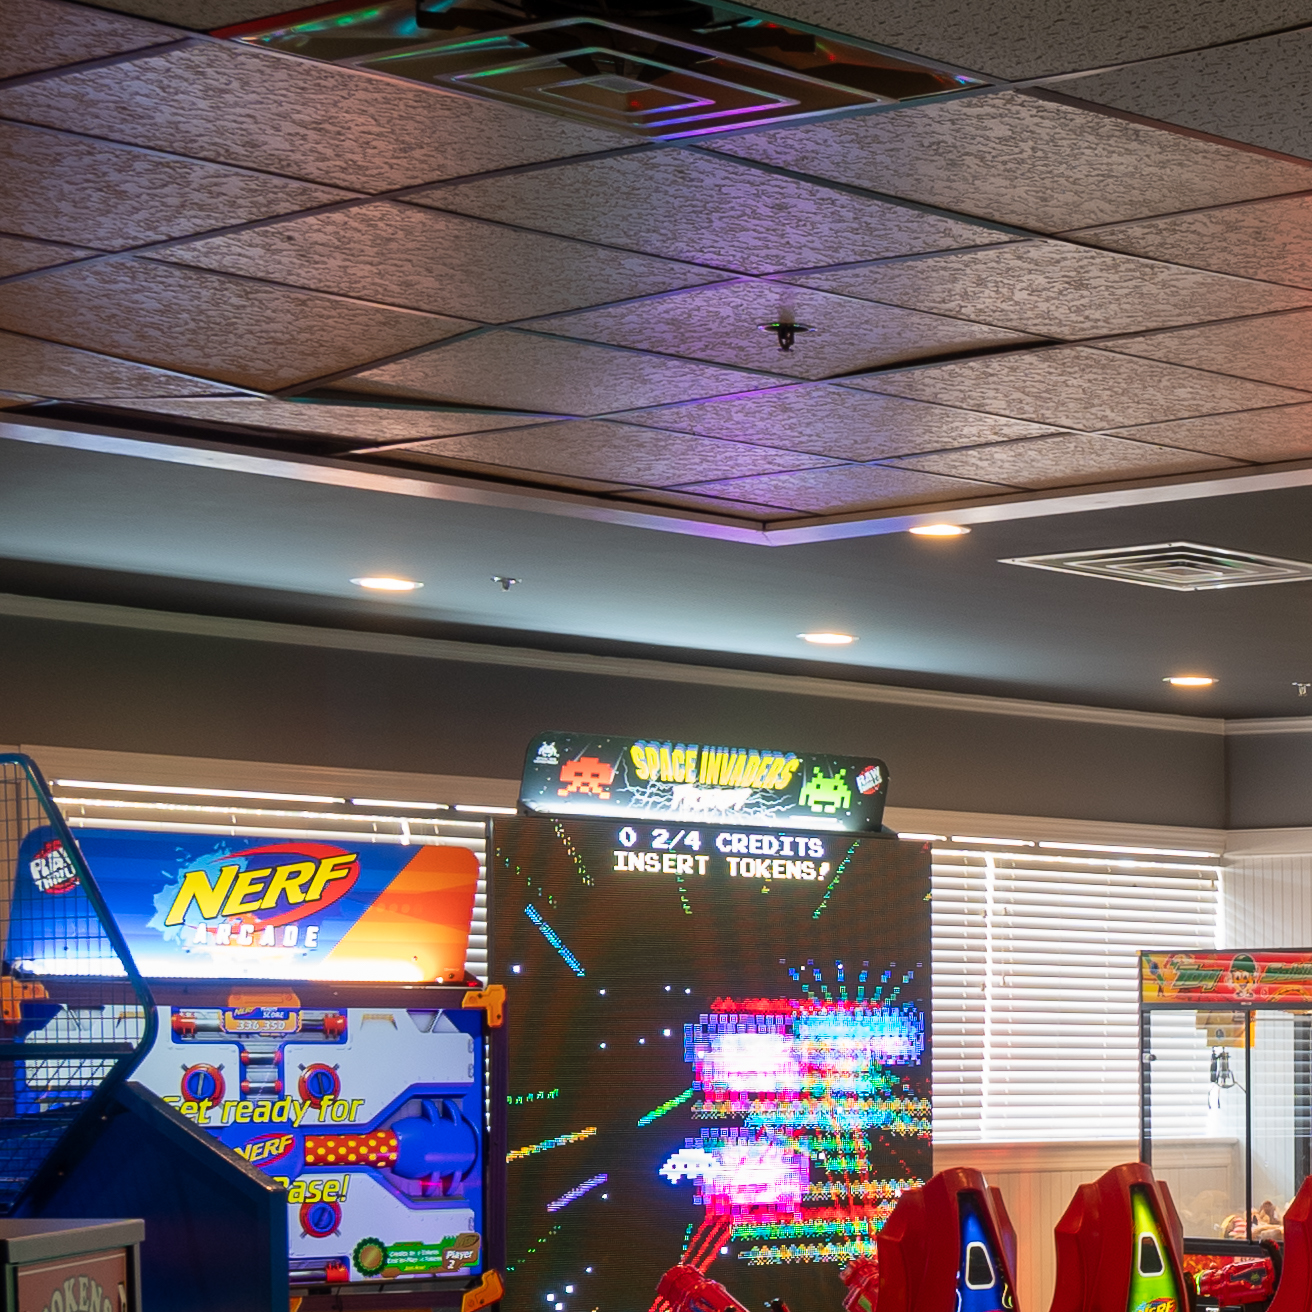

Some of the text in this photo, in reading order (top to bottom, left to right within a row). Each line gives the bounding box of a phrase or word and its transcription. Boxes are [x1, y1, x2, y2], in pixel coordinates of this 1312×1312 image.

[630, 740, 799, 790] SPACE INVADERS
[652, 828, 701, 850] 2/4
[716, 833, 823, 858] CREDITS
[614, 851, 831, 881] INSERT TOKENS!
[164, 852, 357, 926] NERF
[193, 925, 320, 948] ARCADE
[222, 1094, 308, 1127] ready
[318, 1094, 364, 1124] for
[272, 1175, 350, 1203] ase!
[446, 1250, 473, 1261] Player
[447, 1260, 456, 1270] 2
